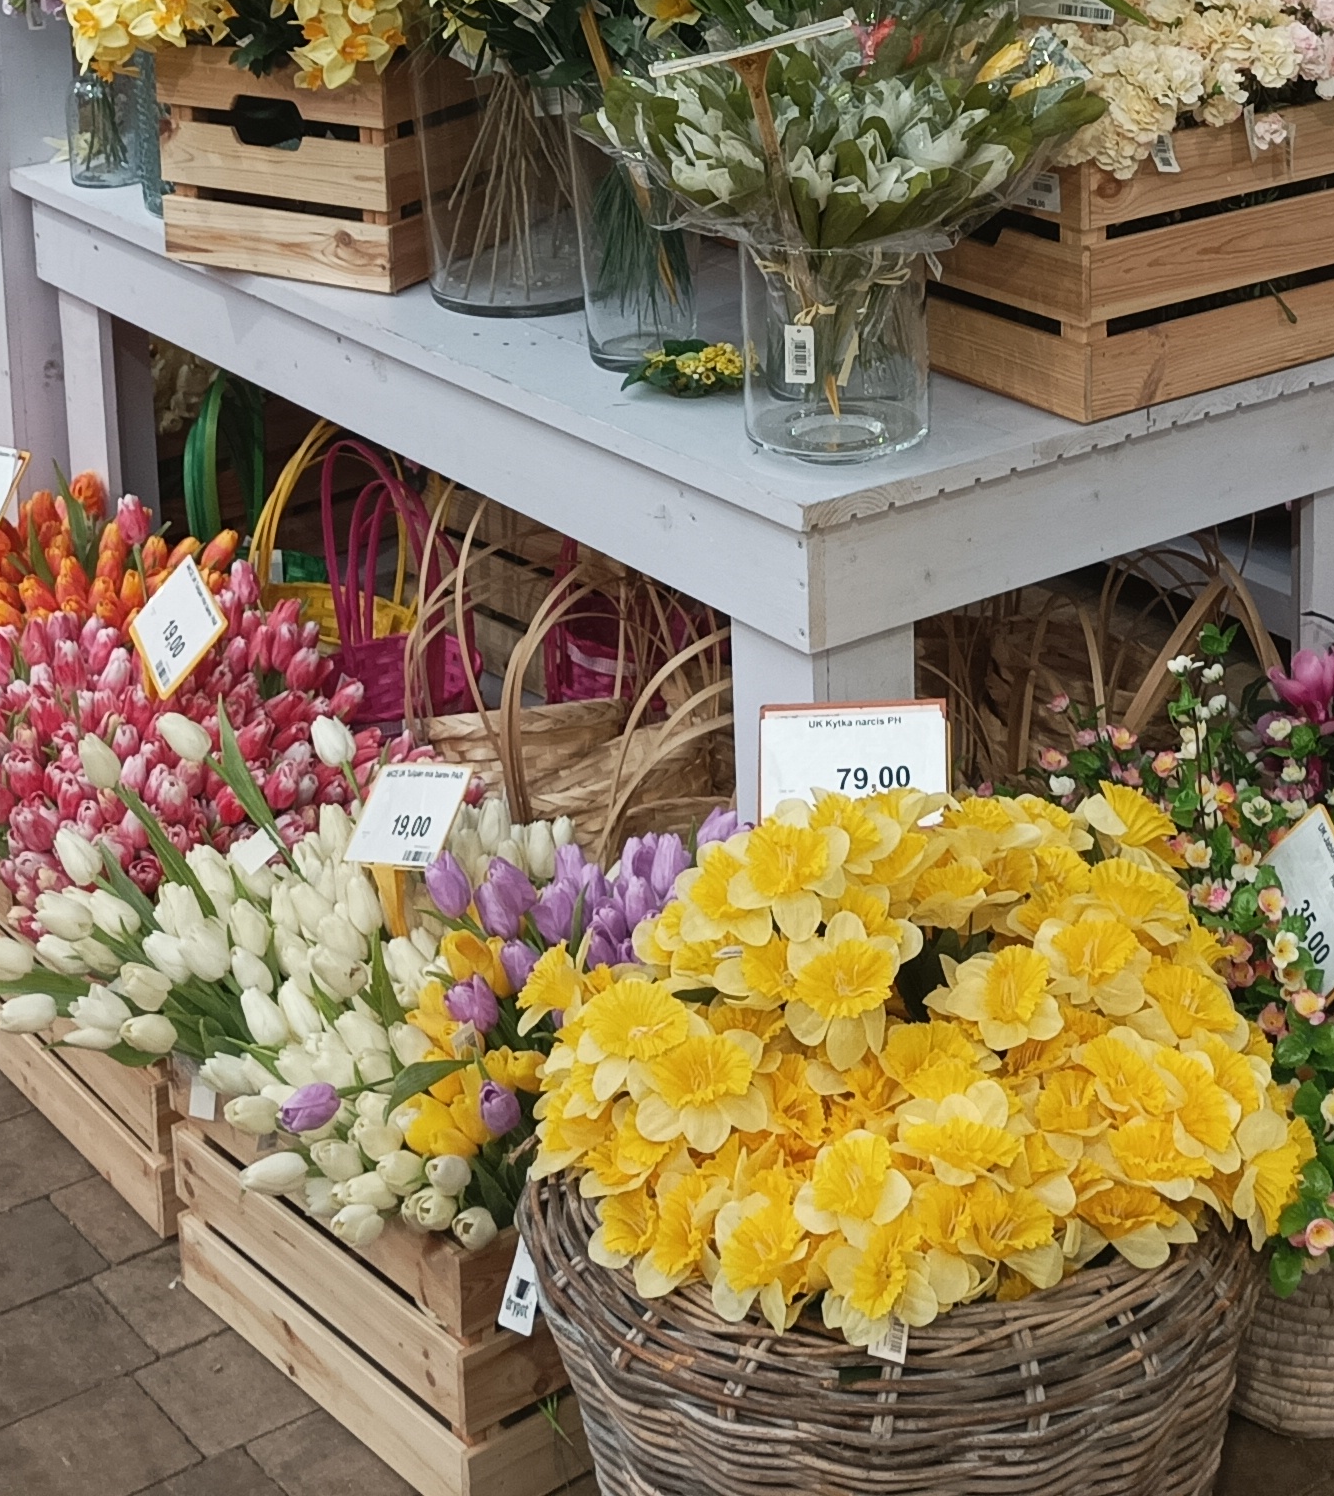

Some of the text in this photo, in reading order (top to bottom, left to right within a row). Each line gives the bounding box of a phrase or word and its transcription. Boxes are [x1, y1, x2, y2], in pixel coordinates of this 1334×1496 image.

[162, 619, 186, 659] 19,00
[808, 716, 902, 730] UK Kytka narcis PH
[836, 765, 911, 794] 79,00
[391, 814, 432, 840] 19,00
[1317, 822, 1328, 836] UK
